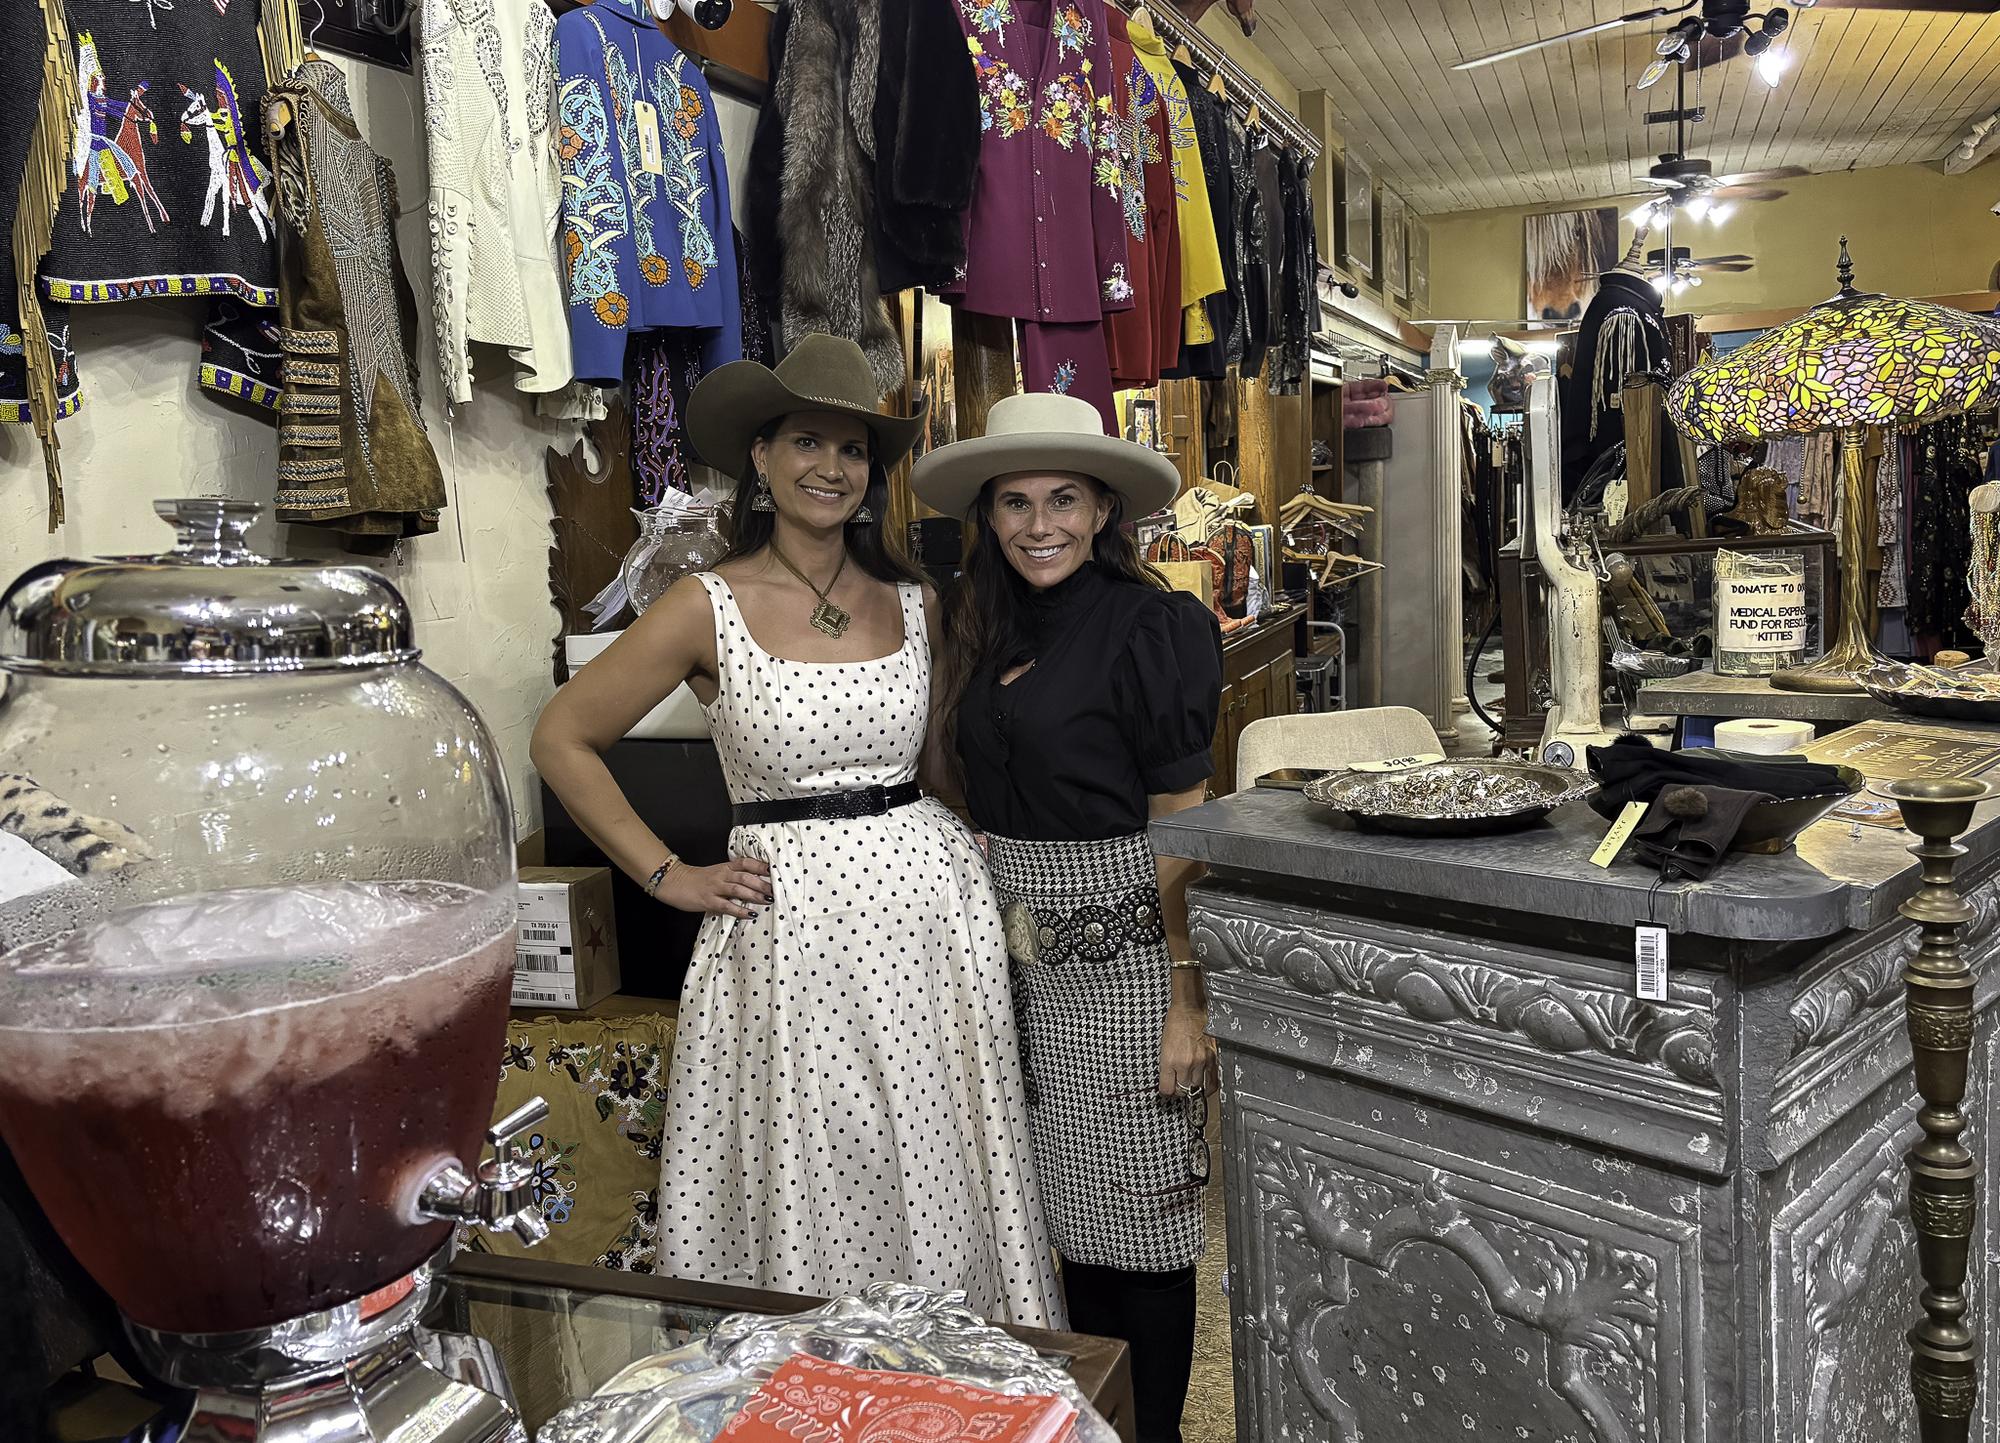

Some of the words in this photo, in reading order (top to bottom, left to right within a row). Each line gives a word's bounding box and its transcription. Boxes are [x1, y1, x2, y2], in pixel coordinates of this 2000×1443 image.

[1731, 585, 1778, 594] DONATE
[1781, 583, 1794, 593] TO
[1730, 607, 1776, 617] MEDICAL
[1730, 619, 1758, 629] FUND
[1760, 619, 1782, 629] FOR
[1757, 631, 1793, 641] KITTIES
